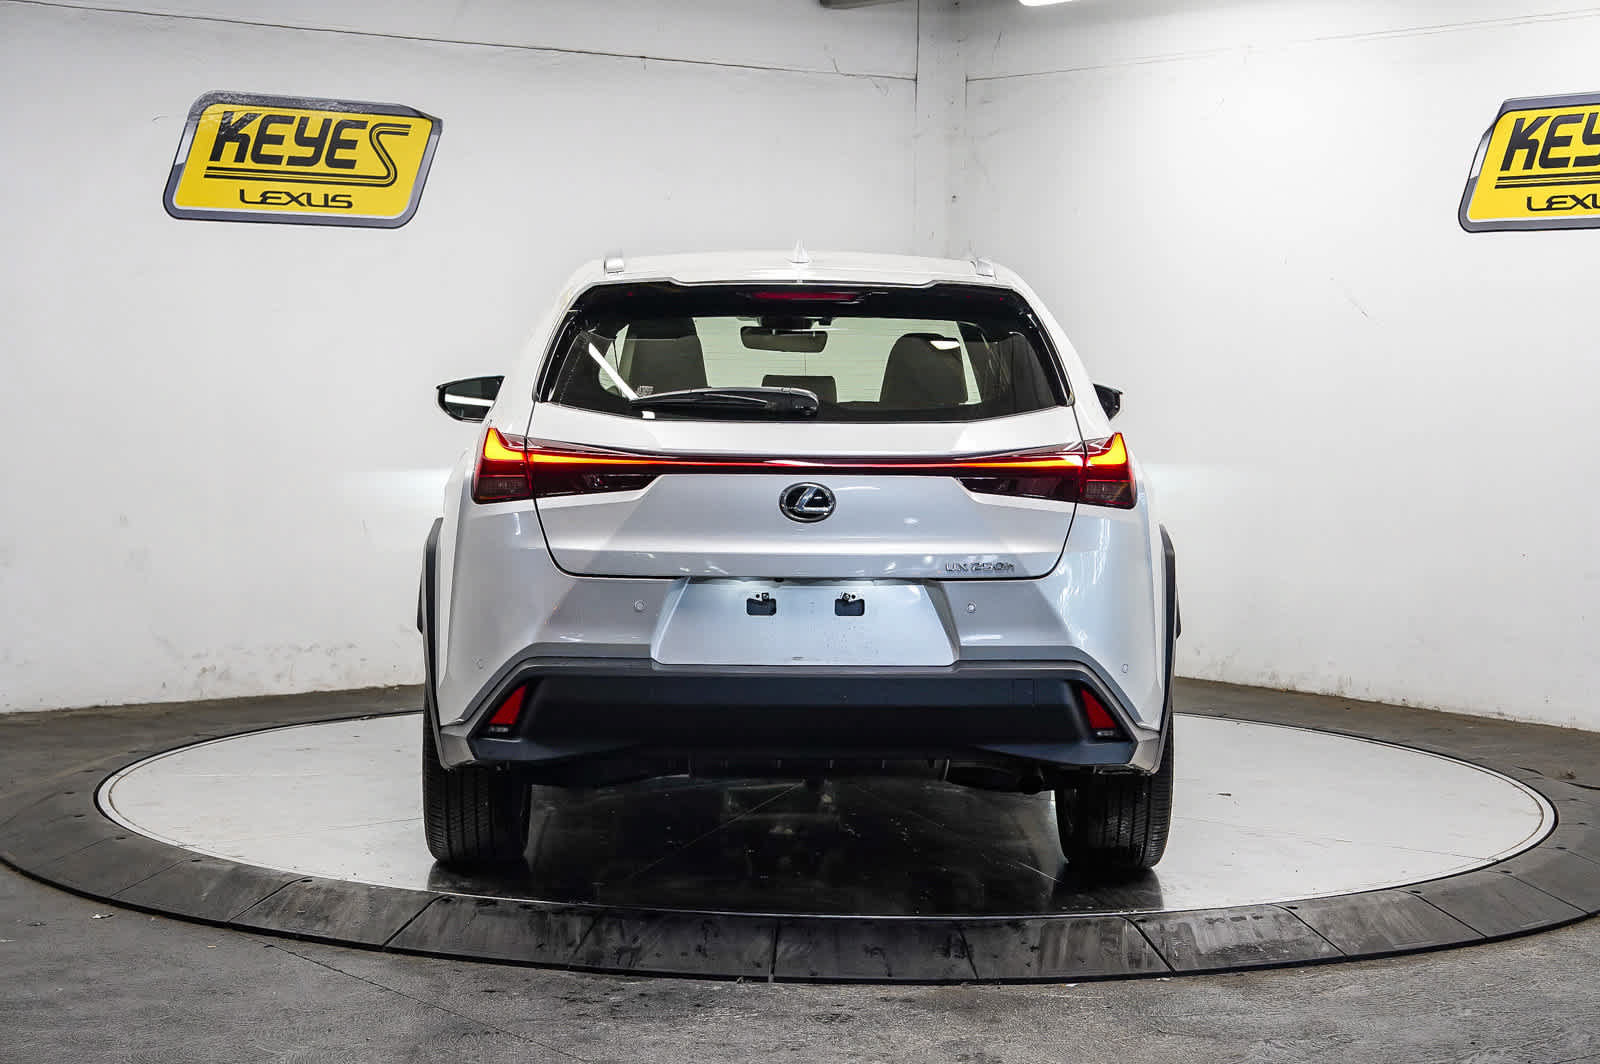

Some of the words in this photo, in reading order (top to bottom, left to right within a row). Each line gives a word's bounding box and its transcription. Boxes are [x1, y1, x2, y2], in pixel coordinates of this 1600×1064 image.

[206, 110, 412, 187] KEYES
[239, 188, 353, 209] LEXUS
[945, 561, 969, 572] UX
